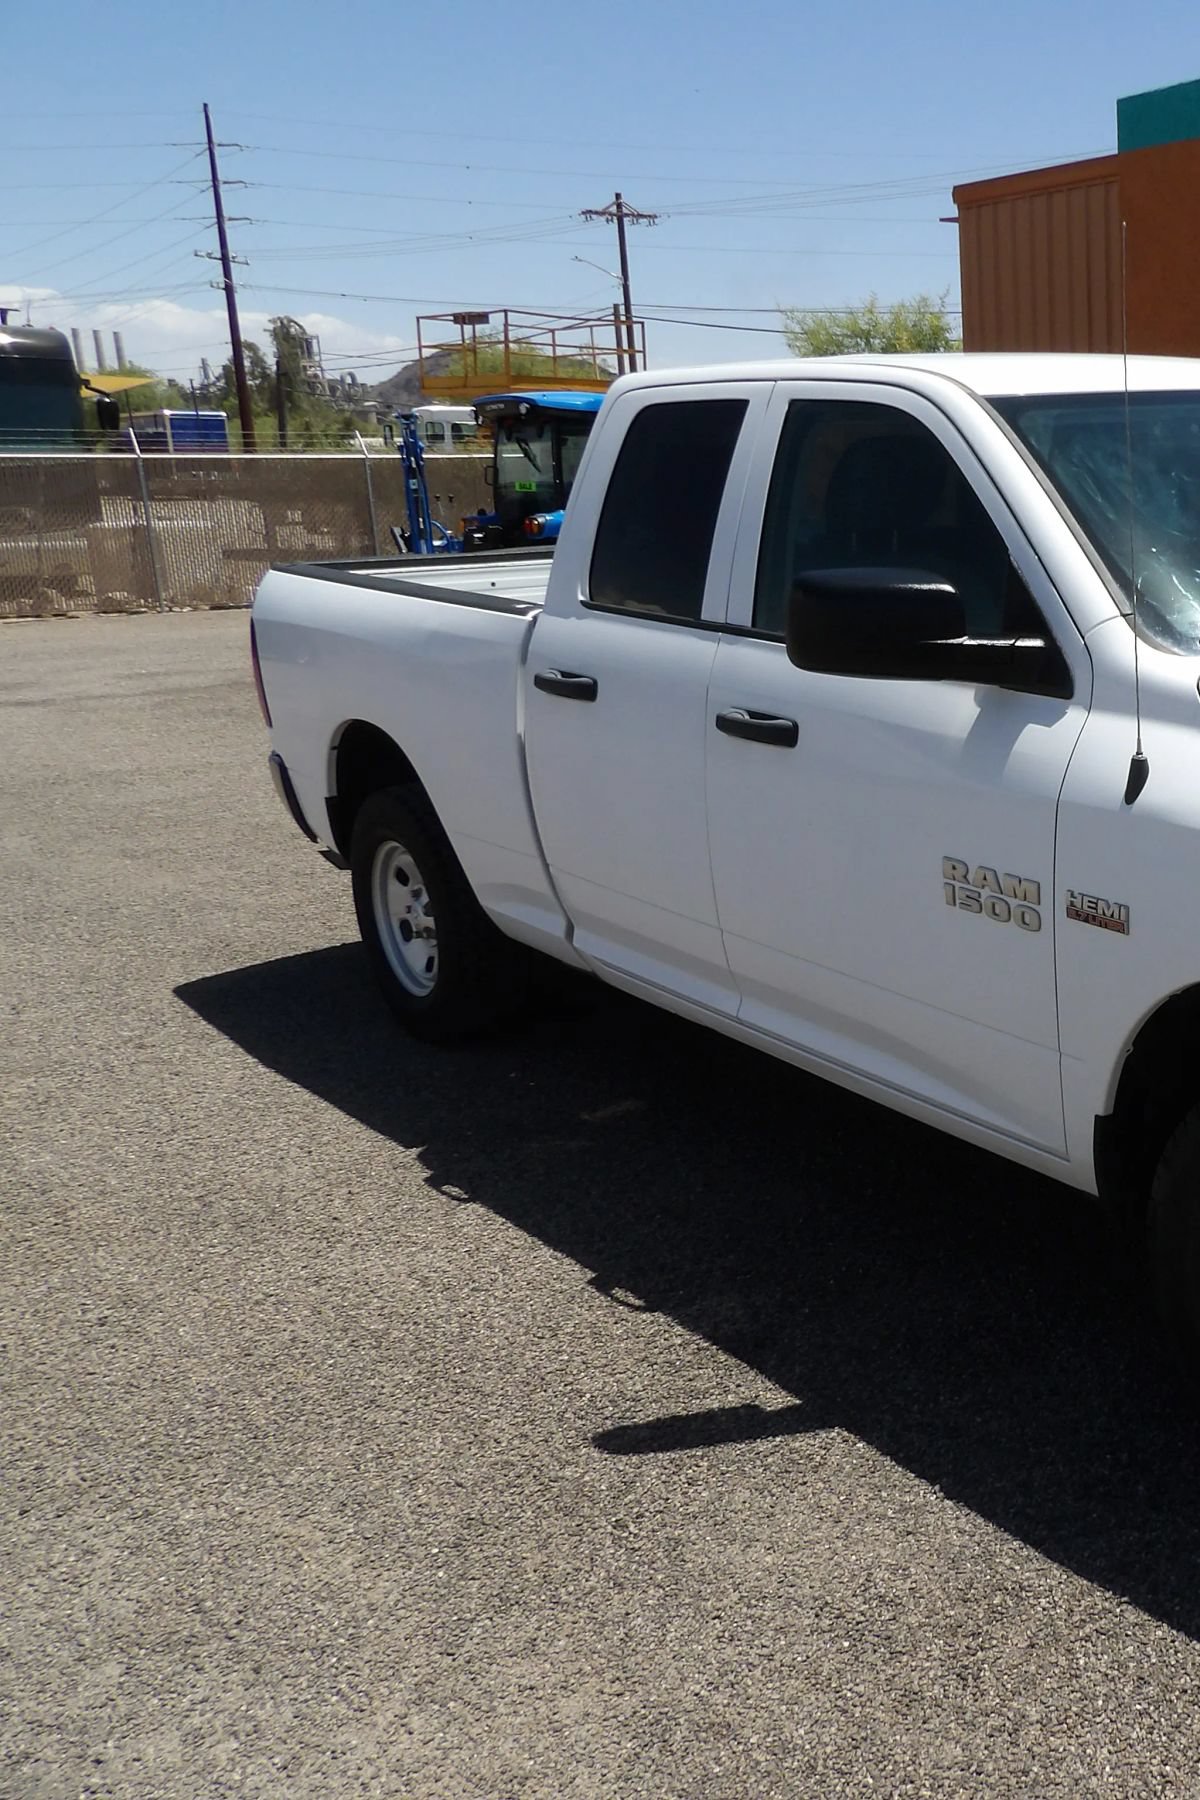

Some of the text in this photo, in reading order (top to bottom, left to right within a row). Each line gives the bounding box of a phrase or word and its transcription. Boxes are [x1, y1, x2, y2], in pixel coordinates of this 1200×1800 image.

[942, 855, 1041, 906] RAM
[1065, 889, 1130, 922] HEMI
[943, 882, 1042, 932] 1500
